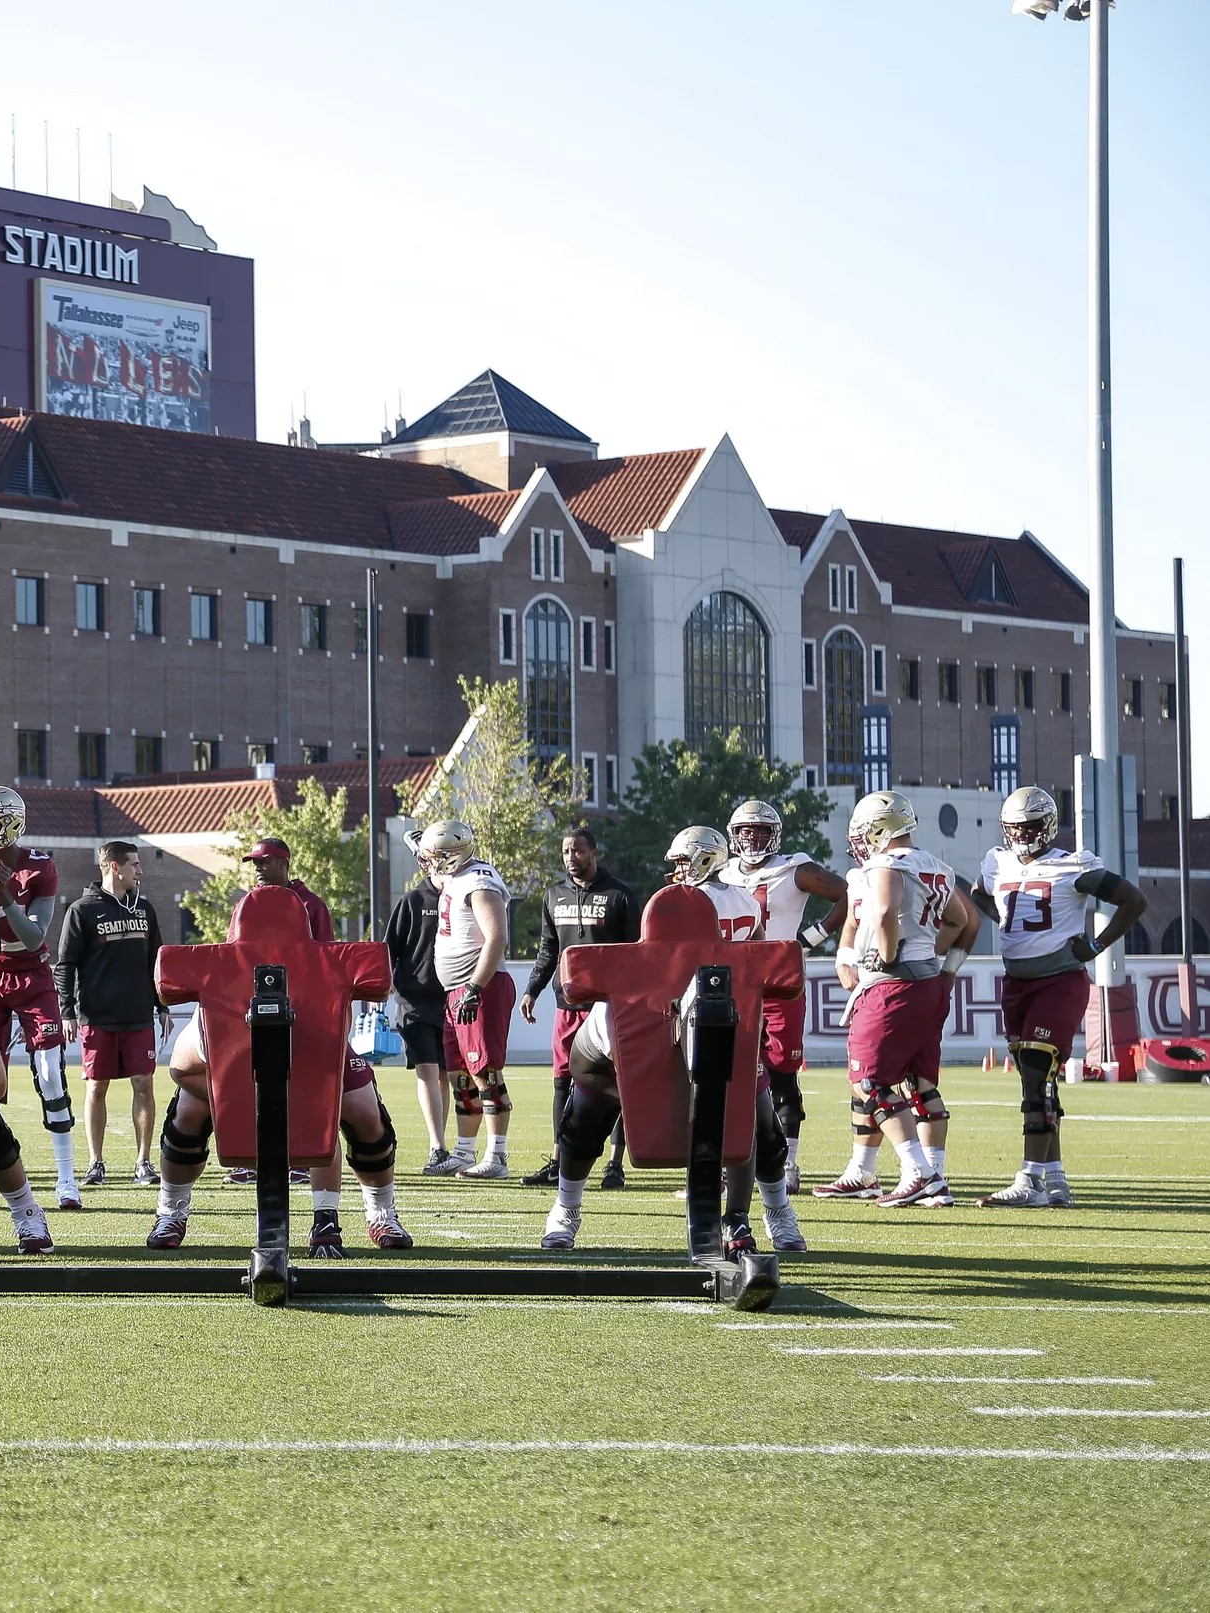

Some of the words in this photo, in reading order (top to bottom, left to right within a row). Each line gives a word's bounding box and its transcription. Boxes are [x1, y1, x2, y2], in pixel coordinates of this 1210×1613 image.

[4, 225, 140, 285] STADIUM
[53, 295, 124, 329] Tallahassee
[173, 315, 200, 335] Jeep
[999, 881, 1052, 933] 73
[1035, 1027, 1051, 1038] FSU
[350, 1058, 366, 1067] FSU
